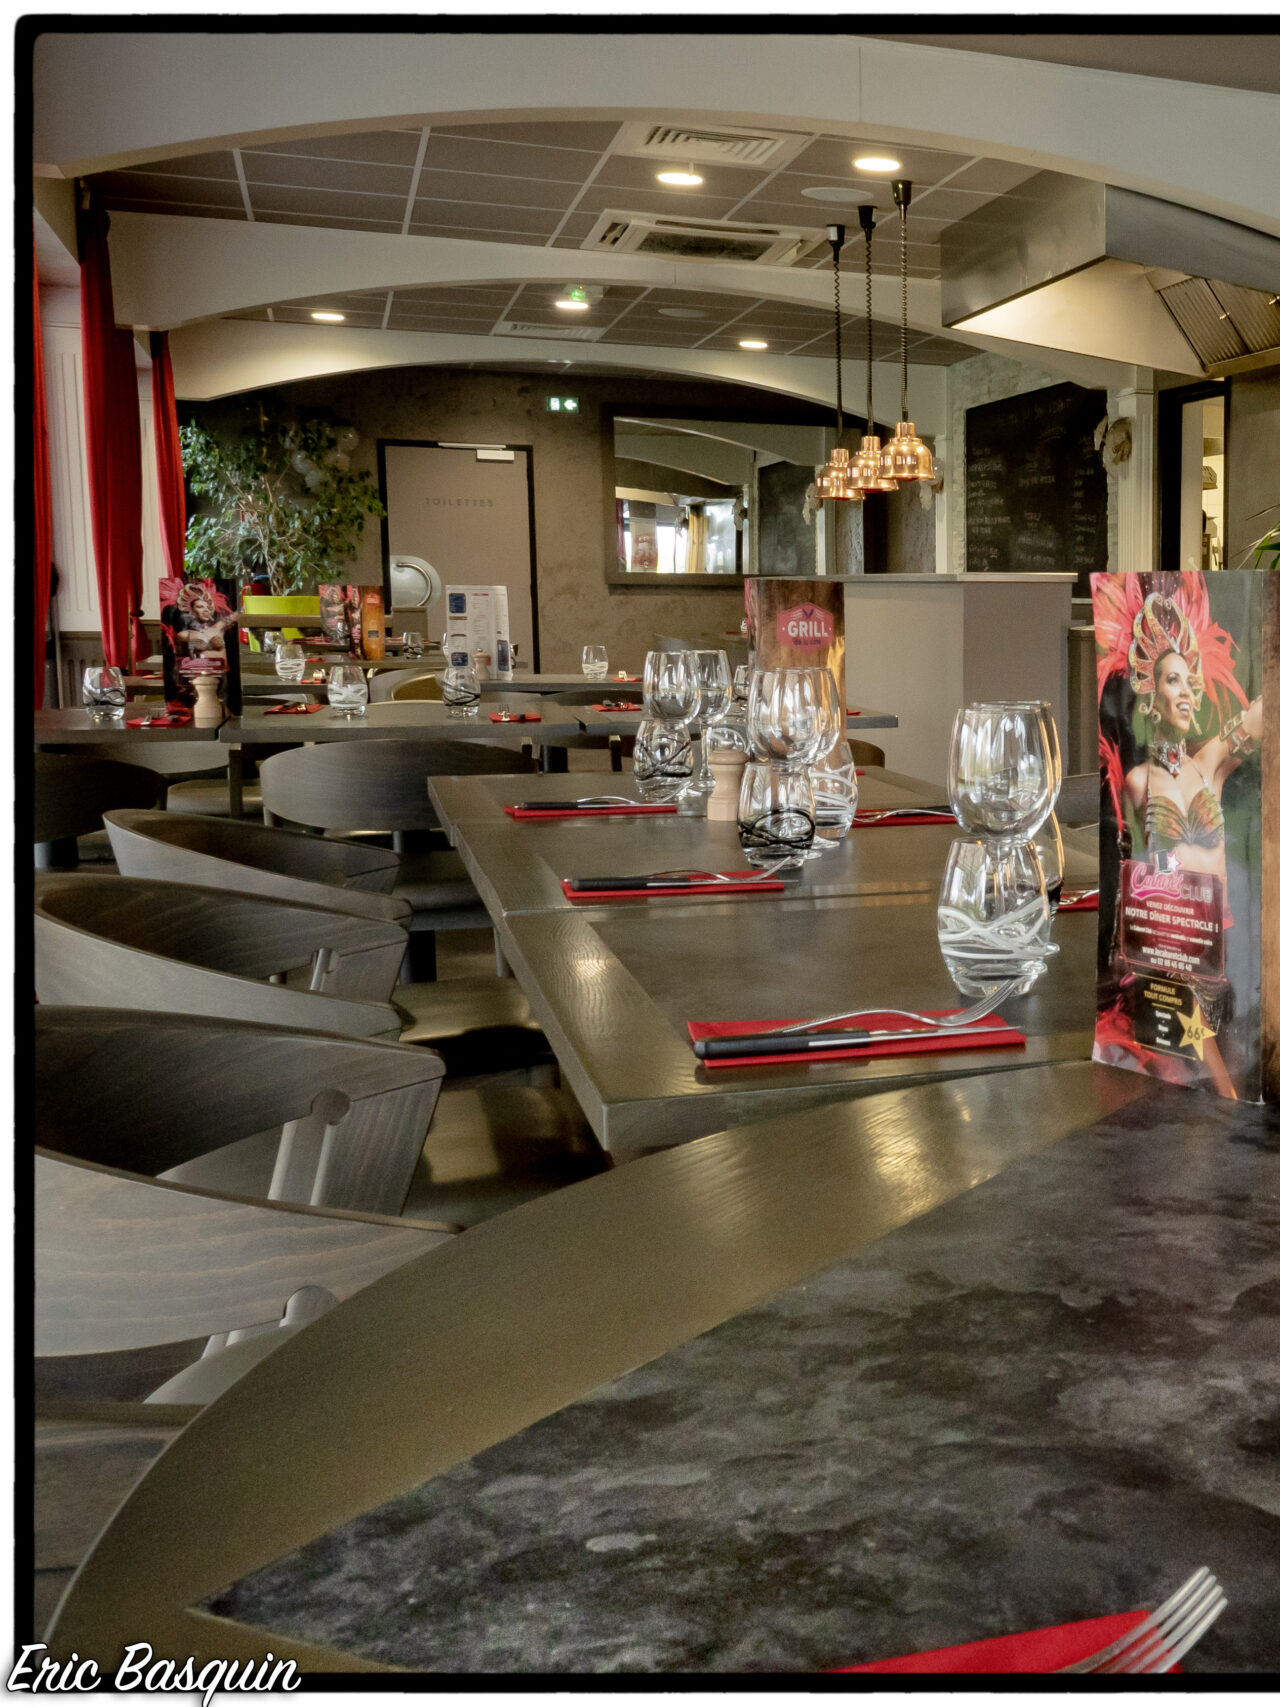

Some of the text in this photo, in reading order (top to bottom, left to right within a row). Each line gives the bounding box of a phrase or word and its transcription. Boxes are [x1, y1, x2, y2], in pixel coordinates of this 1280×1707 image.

[425, 497, 494, 507] TOILETTES
[787, 620, 828, 637] GRILL
[1181, 883, 1213, 904] CLUB
[1125, 907, 1149, 919] NOTRE
[1149, 910, 1172, 924] DÎNER
[1172, 916, 1214, 932] SPECTACLE
[1150, 982, 1176, 995] FORMULE
[1143, 990, 1183, 1006] TOUT COMPRIS
